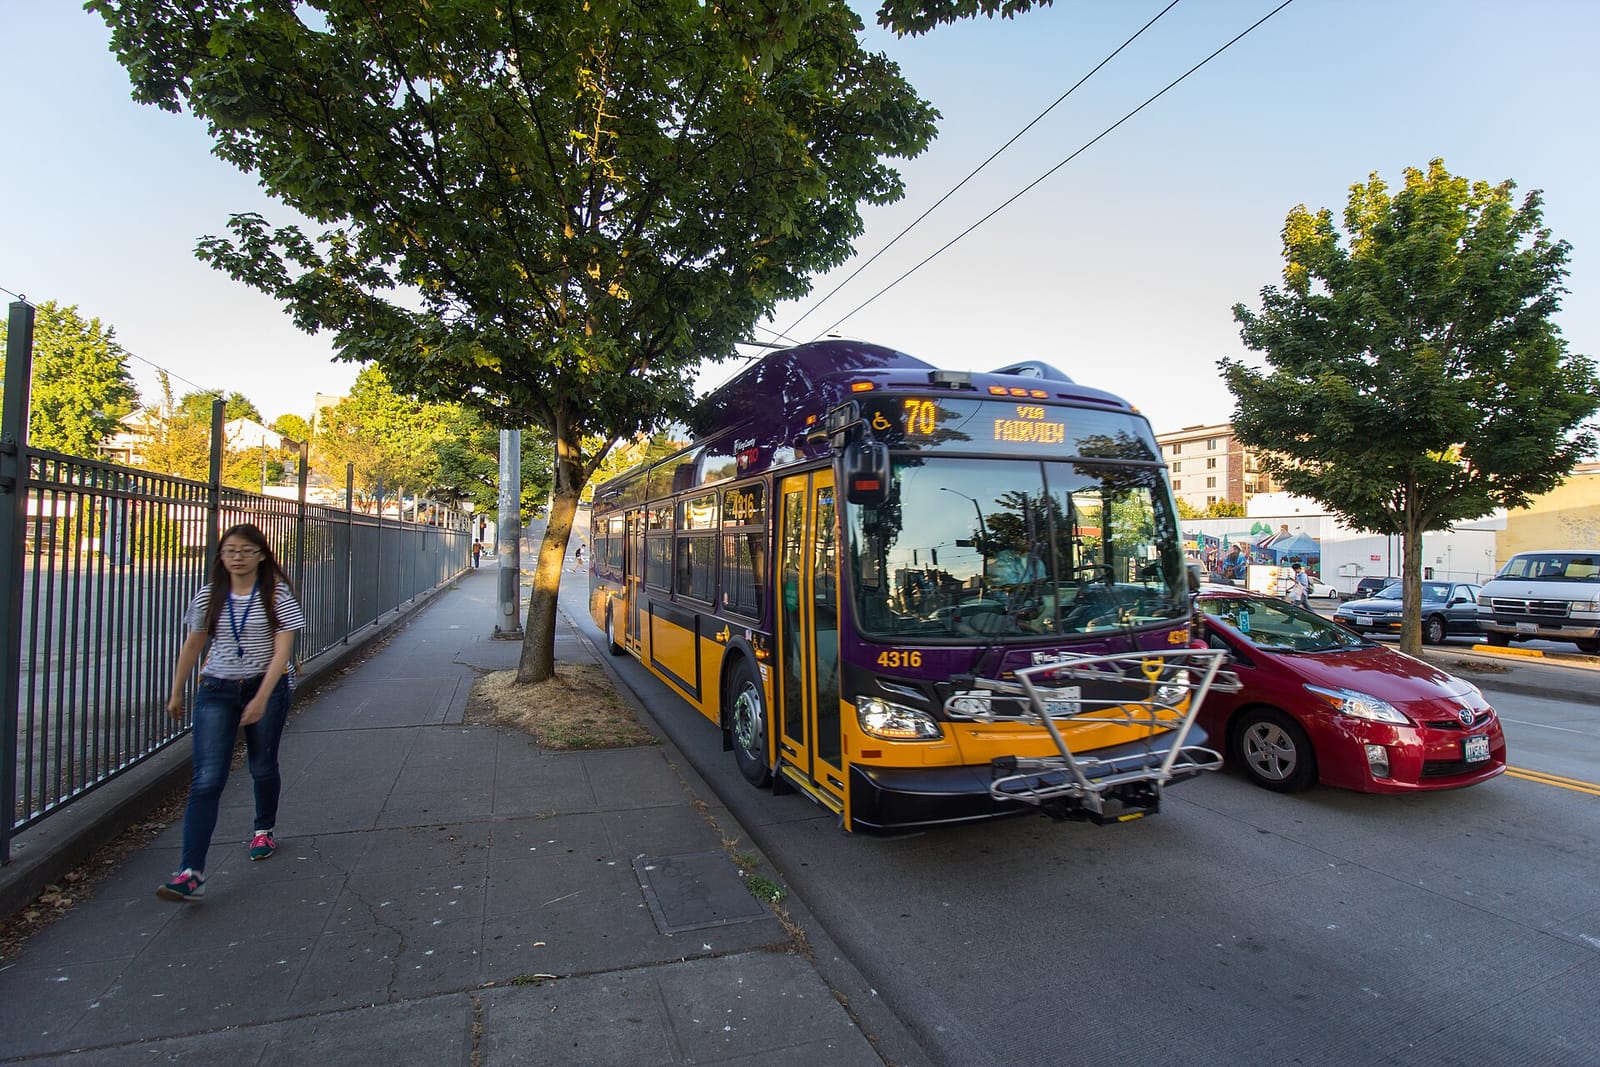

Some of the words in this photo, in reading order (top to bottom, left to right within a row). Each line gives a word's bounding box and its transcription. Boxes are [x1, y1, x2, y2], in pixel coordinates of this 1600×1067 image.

[904, 400, 936, 434] 70
[1016, 406, 1045, 419] VIA
[732, 492, 754, 519] 4316
[877, 651, 922, 668] 4316
